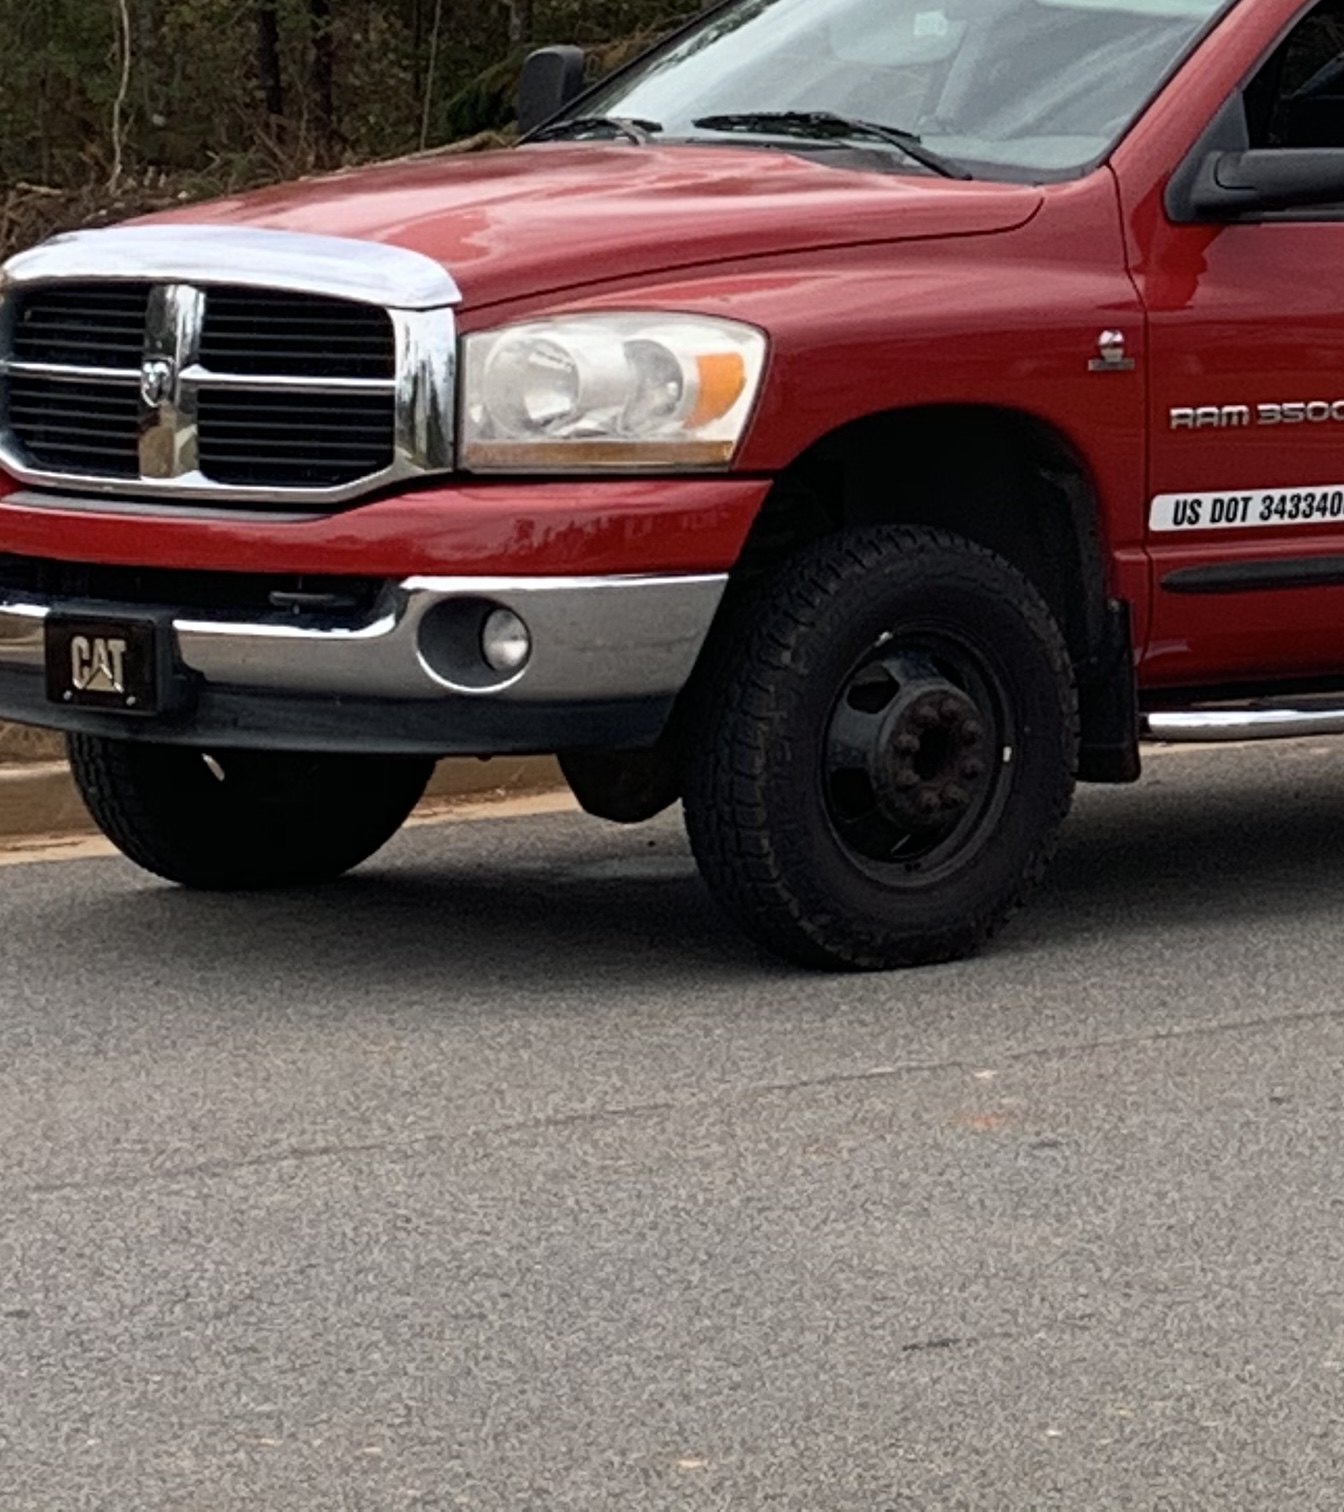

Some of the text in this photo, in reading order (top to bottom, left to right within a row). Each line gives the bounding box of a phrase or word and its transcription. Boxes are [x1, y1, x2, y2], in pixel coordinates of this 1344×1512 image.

[1170, 404, 1250, 430] RAM
[1172, 498, 1203, 526] US
[1209, 496, 1254, 524] DOT
[71, 635, 127, 693] CAT
